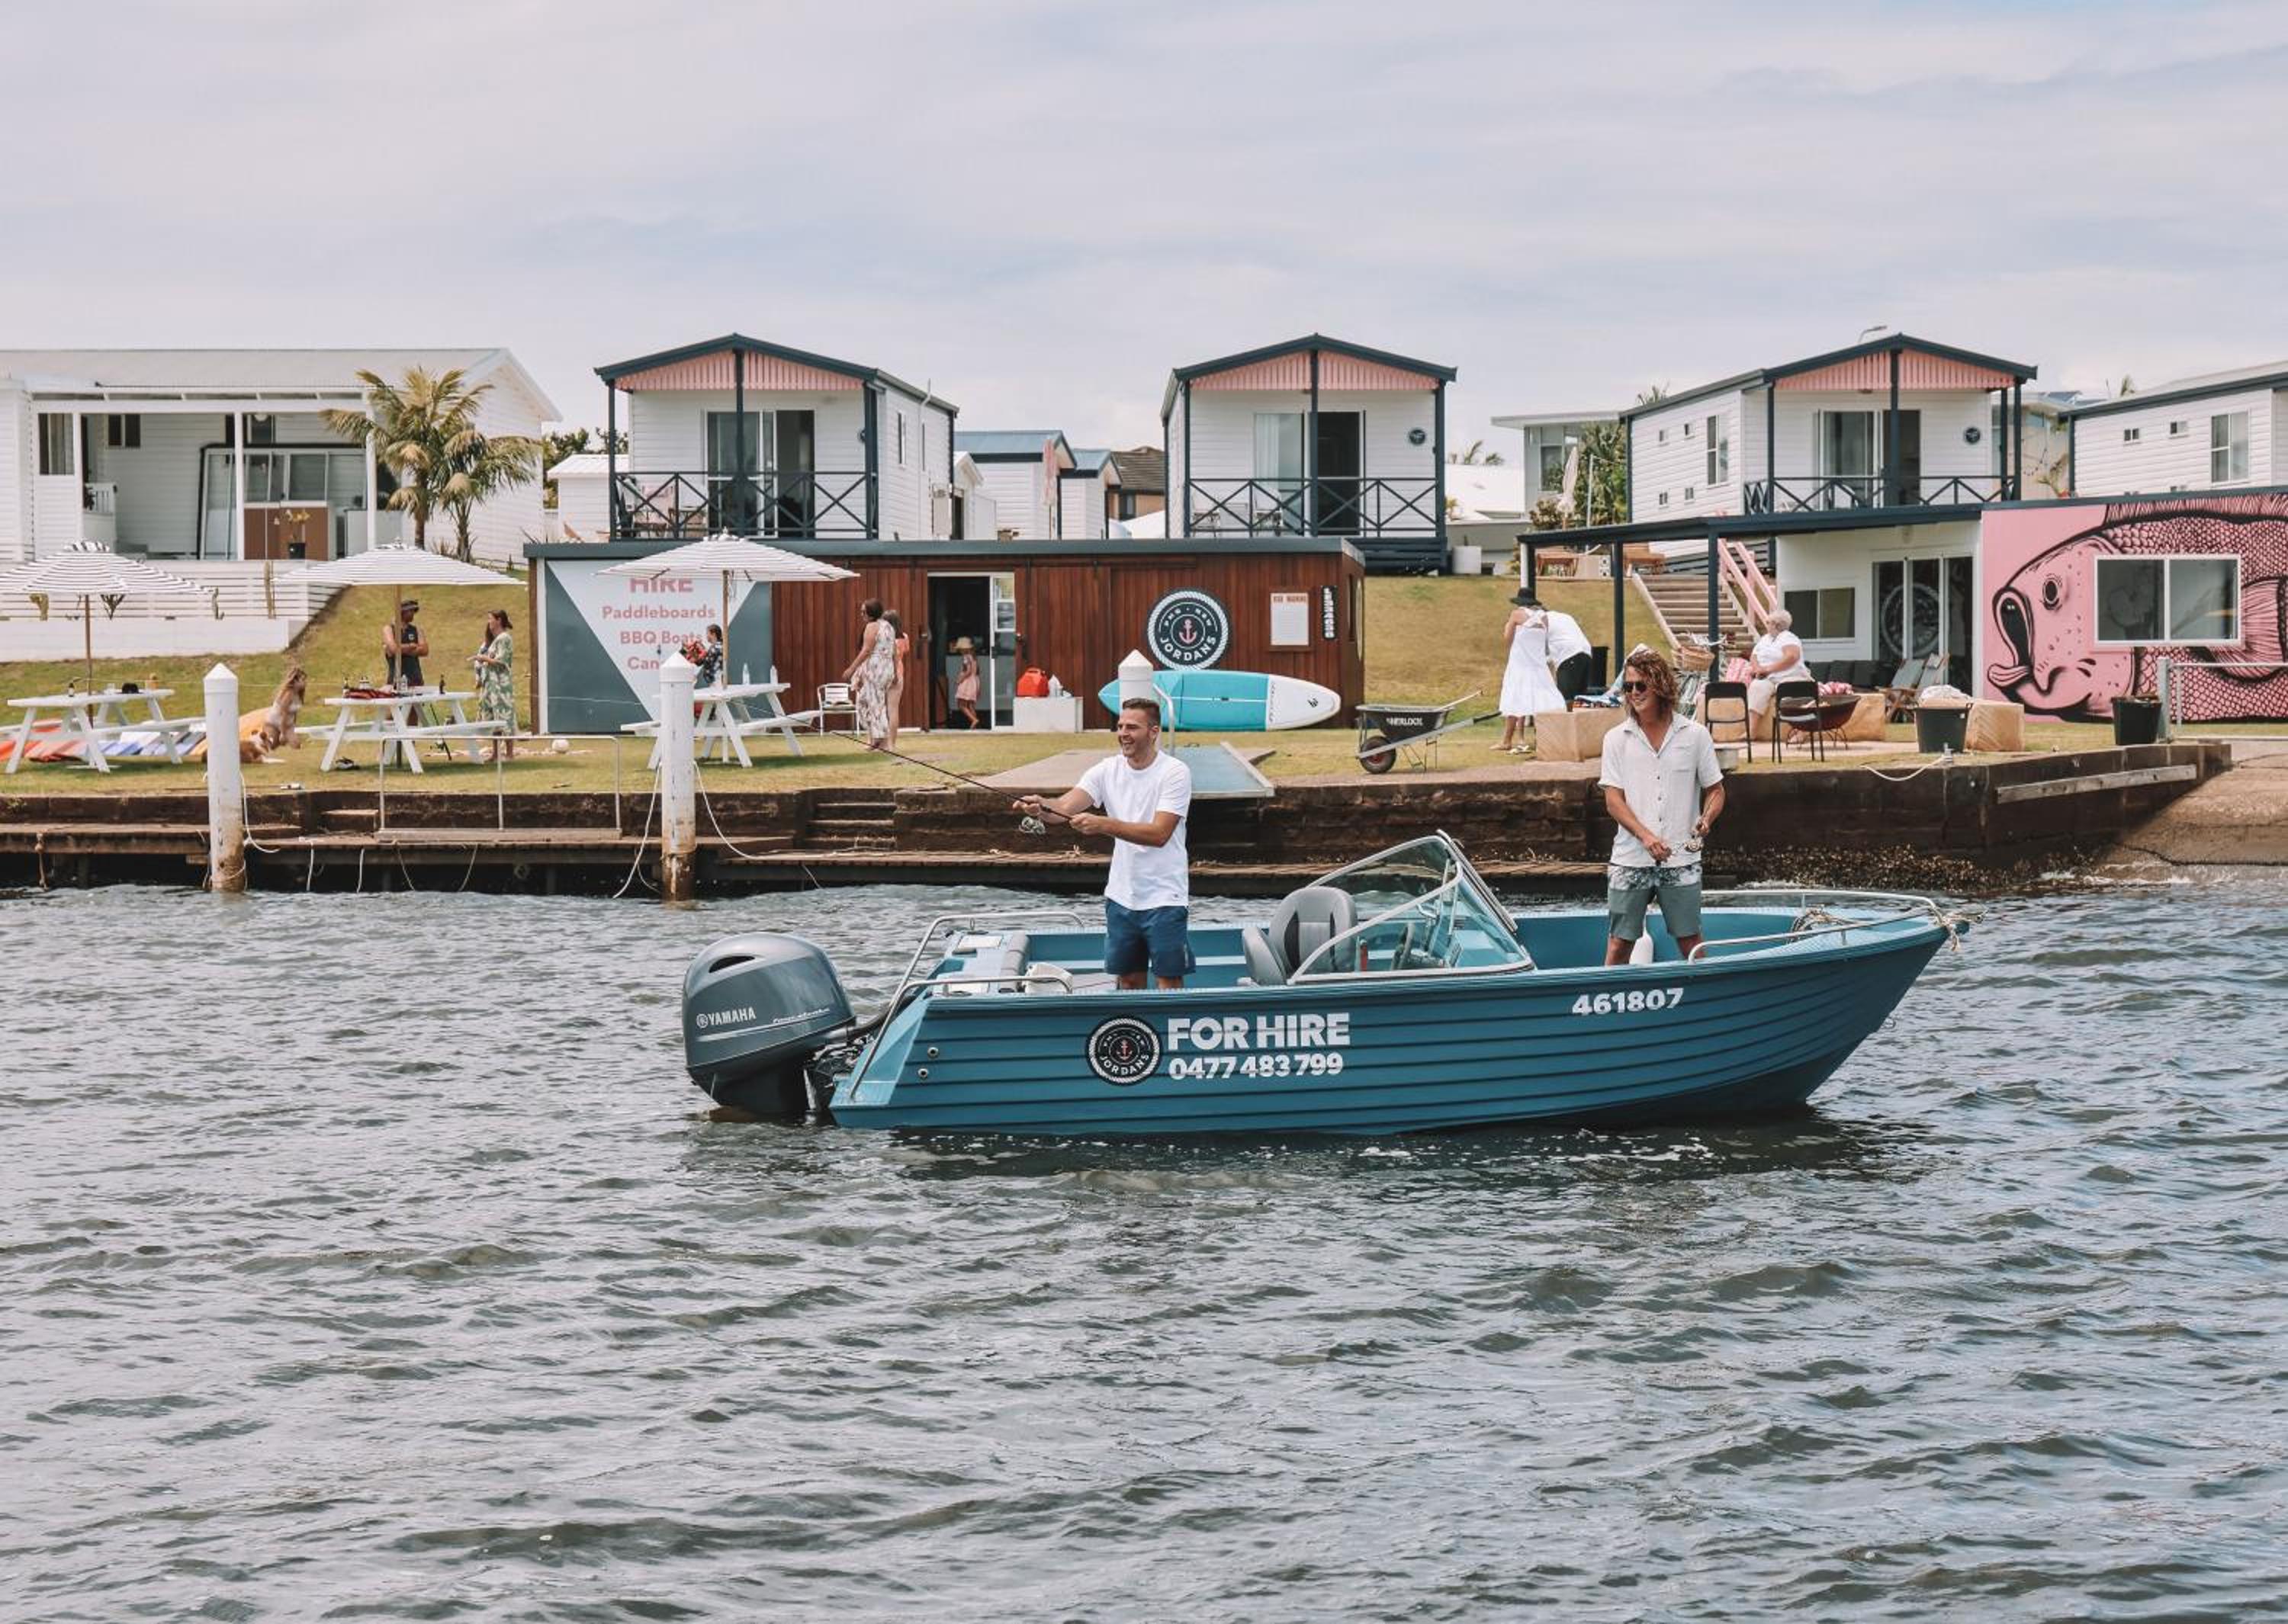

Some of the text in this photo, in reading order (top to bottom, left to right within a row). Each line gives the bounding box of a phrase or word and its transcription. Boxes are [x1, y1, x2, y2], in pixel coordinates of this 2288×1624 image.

[602, 605, 716, 619] Paddleboards
[620, 631, 657, 645] BBQ
[1160, 636, 1216, 661] JORDANS
[1571, 987, 1684, 1016] 461807
[708, 1006, 757, 1025] YAMAHA
[1168, 1013, 1351, 1051] FOR HIRE
[1099, 1054, 1149, 1076] JORDANS
[1168, 1052, 1344, 1080] 0477 483 799
